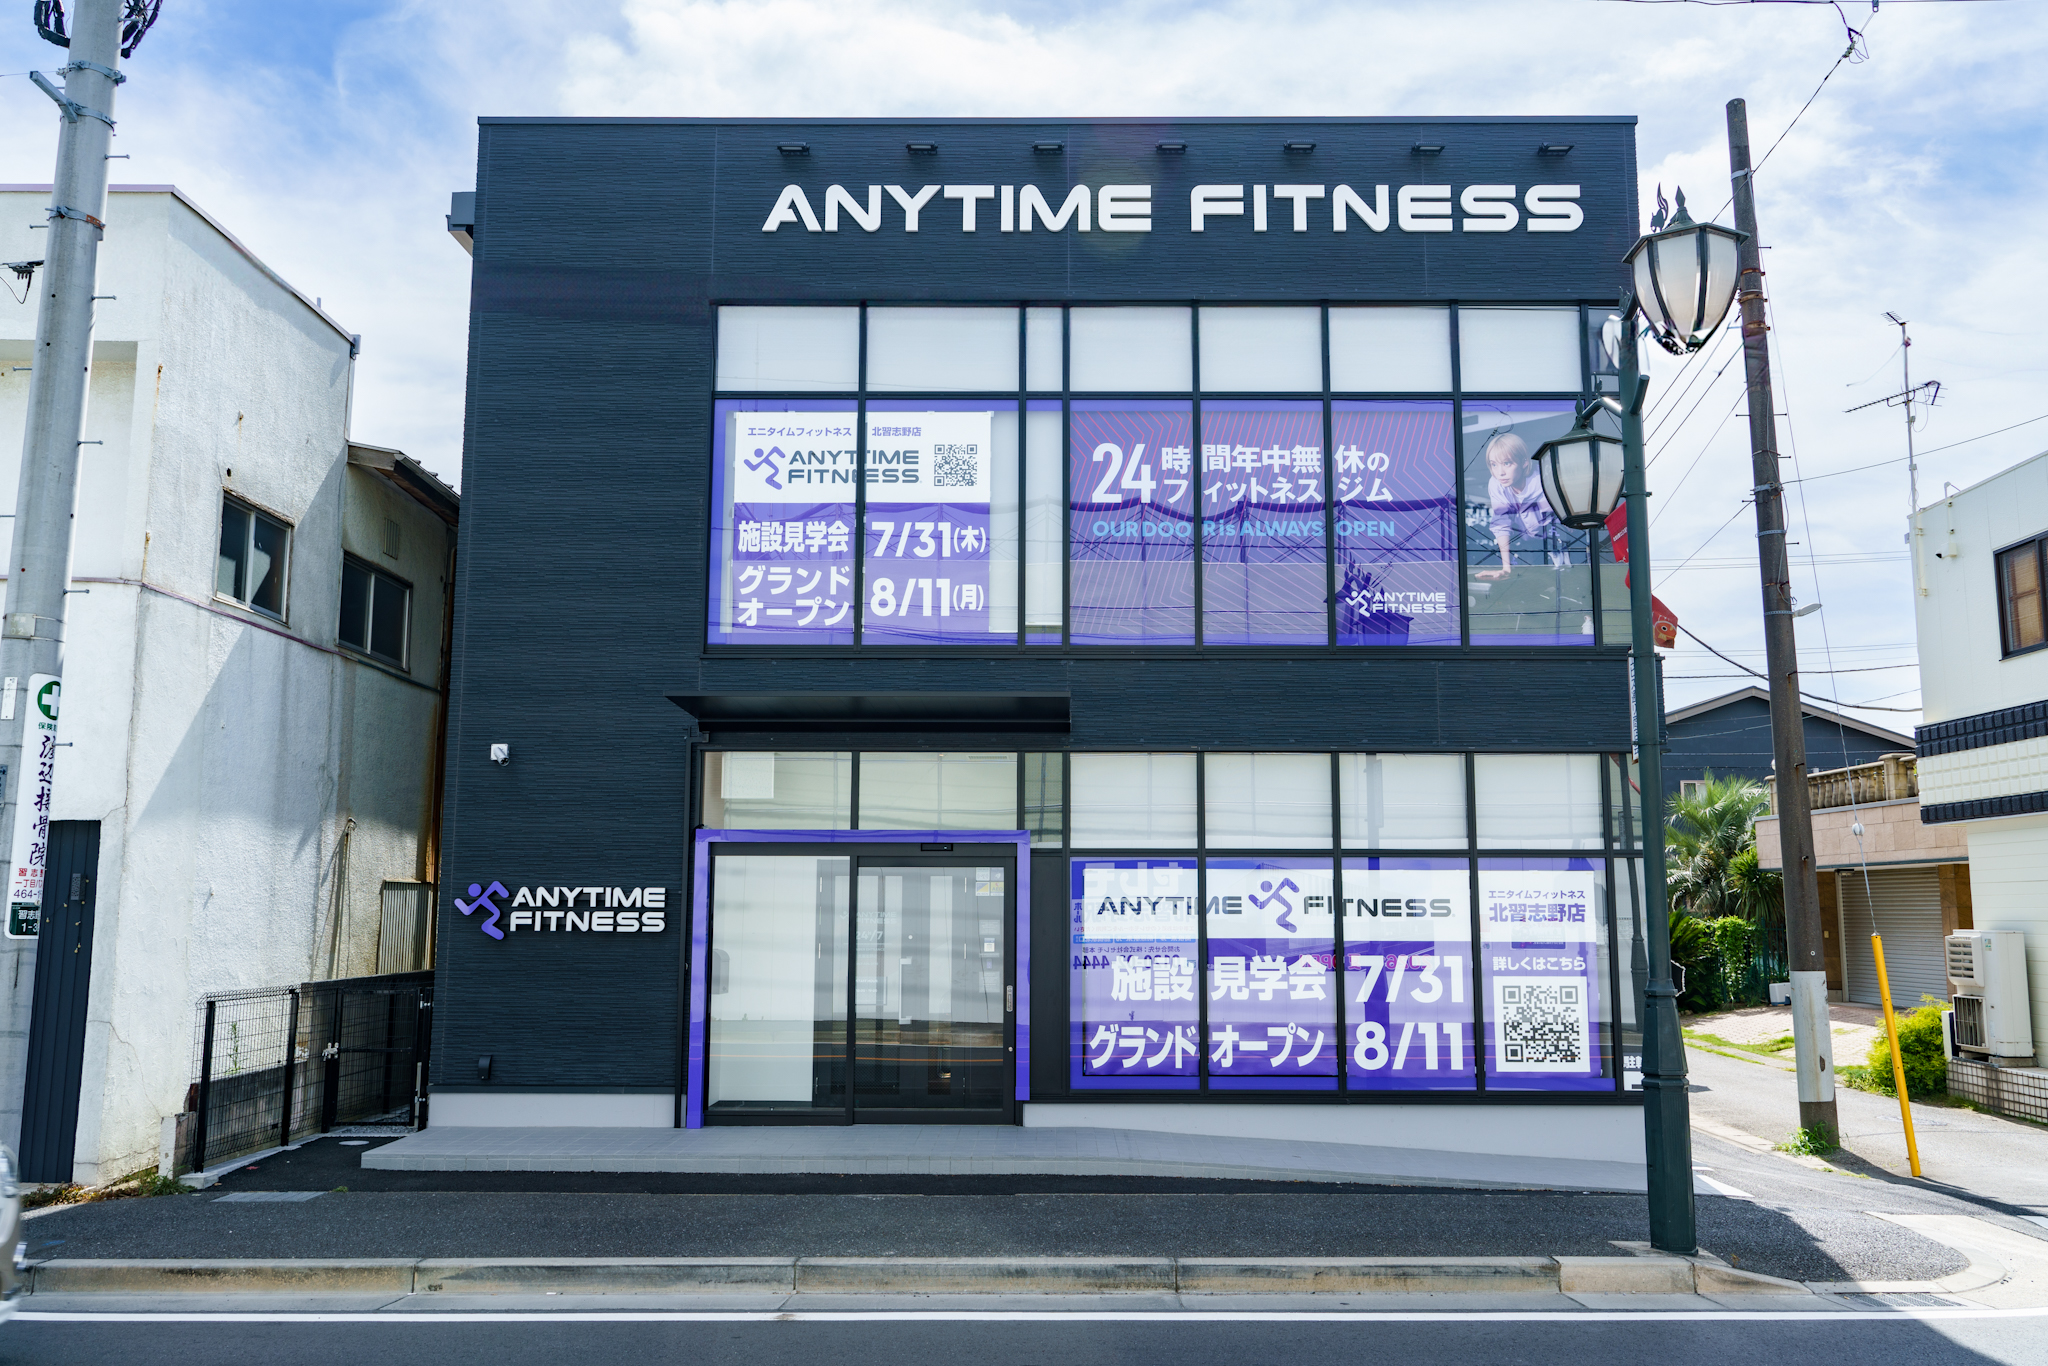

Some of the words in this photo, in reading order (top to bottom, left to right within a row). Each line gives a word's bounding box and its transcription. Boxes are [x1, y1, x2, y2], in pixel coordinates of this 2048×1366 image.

[761, 184, 1153, 233] ANYTIME
[1189, 184, 1584, 233] FITNESS
[747, 427, 852, 437] エニタイムフィットネス
[871, 426, 922, 437] 北習志野店
[789, 449, 920, 465] ANYTIME
[788, 468, 920, 484] FITNESS
[1092, 520, 1138, 537] OUR
[1219, 519, 1236, 537] is
[1239, 520, 1324, 537] ALWAYS
[1335, 521, 1396, 537] OPEN
[737, 520, 850, 554] 施設見学会
[871, 521, 987, 558] 7/31(木)
[738, 565, 851, 595] グランド
[869, 577, 985, 617] 8/11(月)
[1372, 591, 1446, 602] ANYTIME
[737, 597, 850, 627] オープン
[1372, 603, 1447, 613] FITNESS
[511, 886, 666, 908] ANYTIME
[1488, 889, 1586, 900] エニタイムフィットネス
[1097, 896, 1243, 916] ANYTIME
[1303, 896, 1451, 917] FITNESS
[1488, 902, 1587, 923] 北習志野店
[509, 911, 666, 933] FITNESS
[1492, 956, 1587, 971] 詳しくはこちら
[1110, 954, 1327, 1001] 施設見学会
[1354, 955, 1465, 1004] 7/31
[1089, 1022, 1325, 1069] グランドオープン
[1353, 1020, 1464, 1071] 8/11
